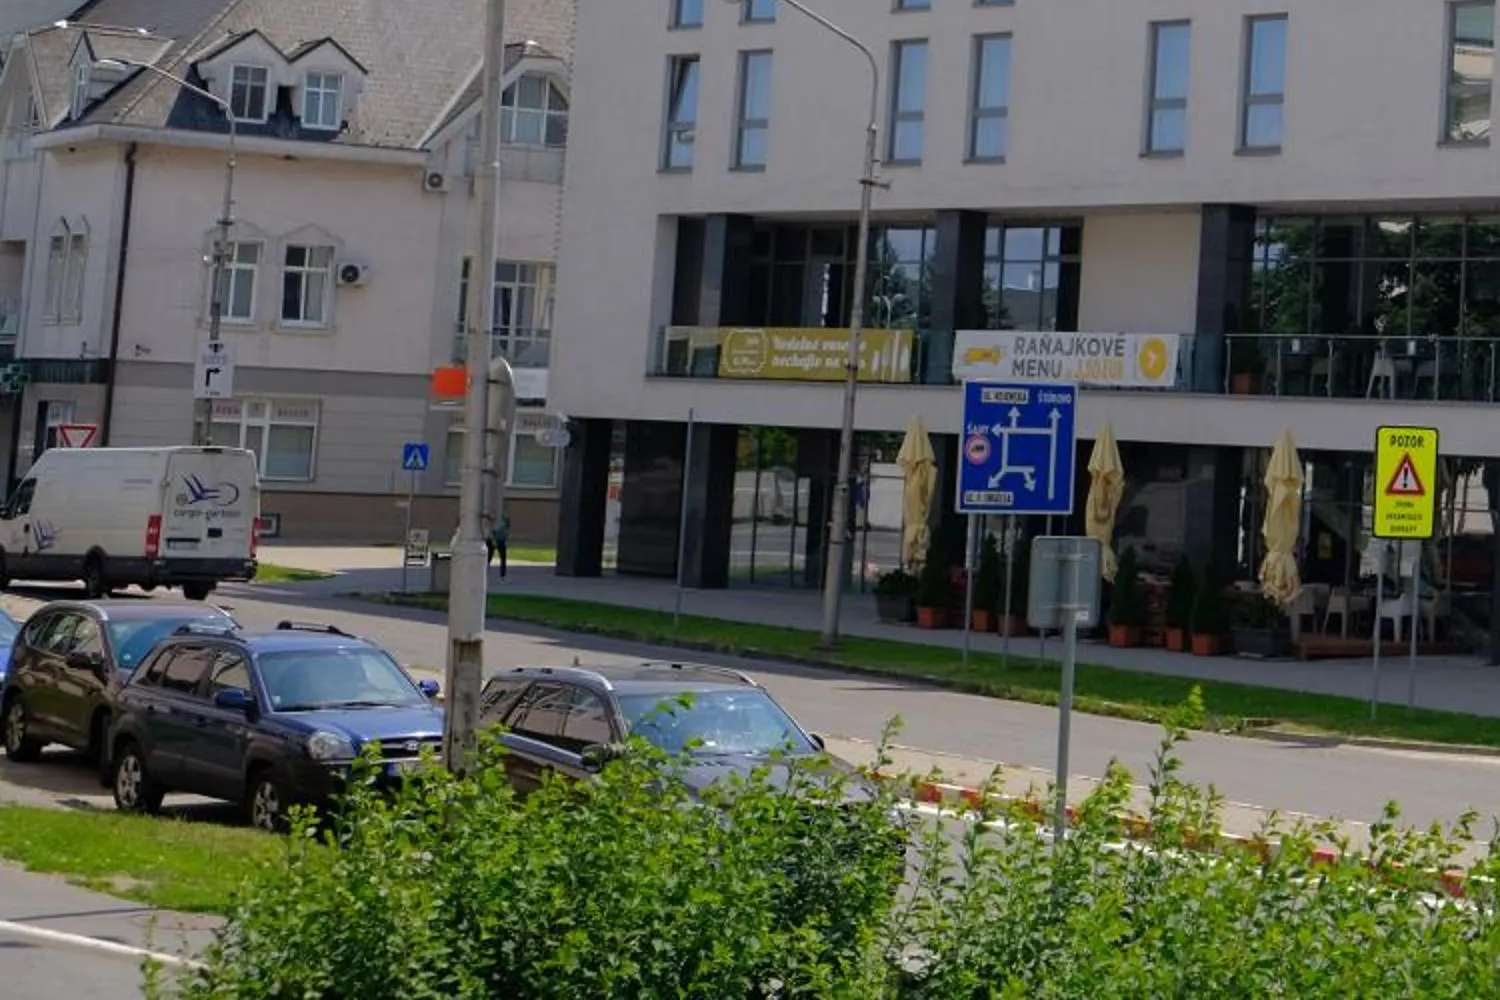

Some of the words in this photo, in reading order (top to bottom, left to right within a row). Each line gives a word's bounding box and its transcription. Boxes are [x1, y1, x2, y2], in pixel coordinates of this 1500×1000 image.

[1013, 332, 1126, 357] RAŇAJKOVÉ
[1012, 359, 1063, 379] MENU
[1389, 435, 1424, 448] POZOR
